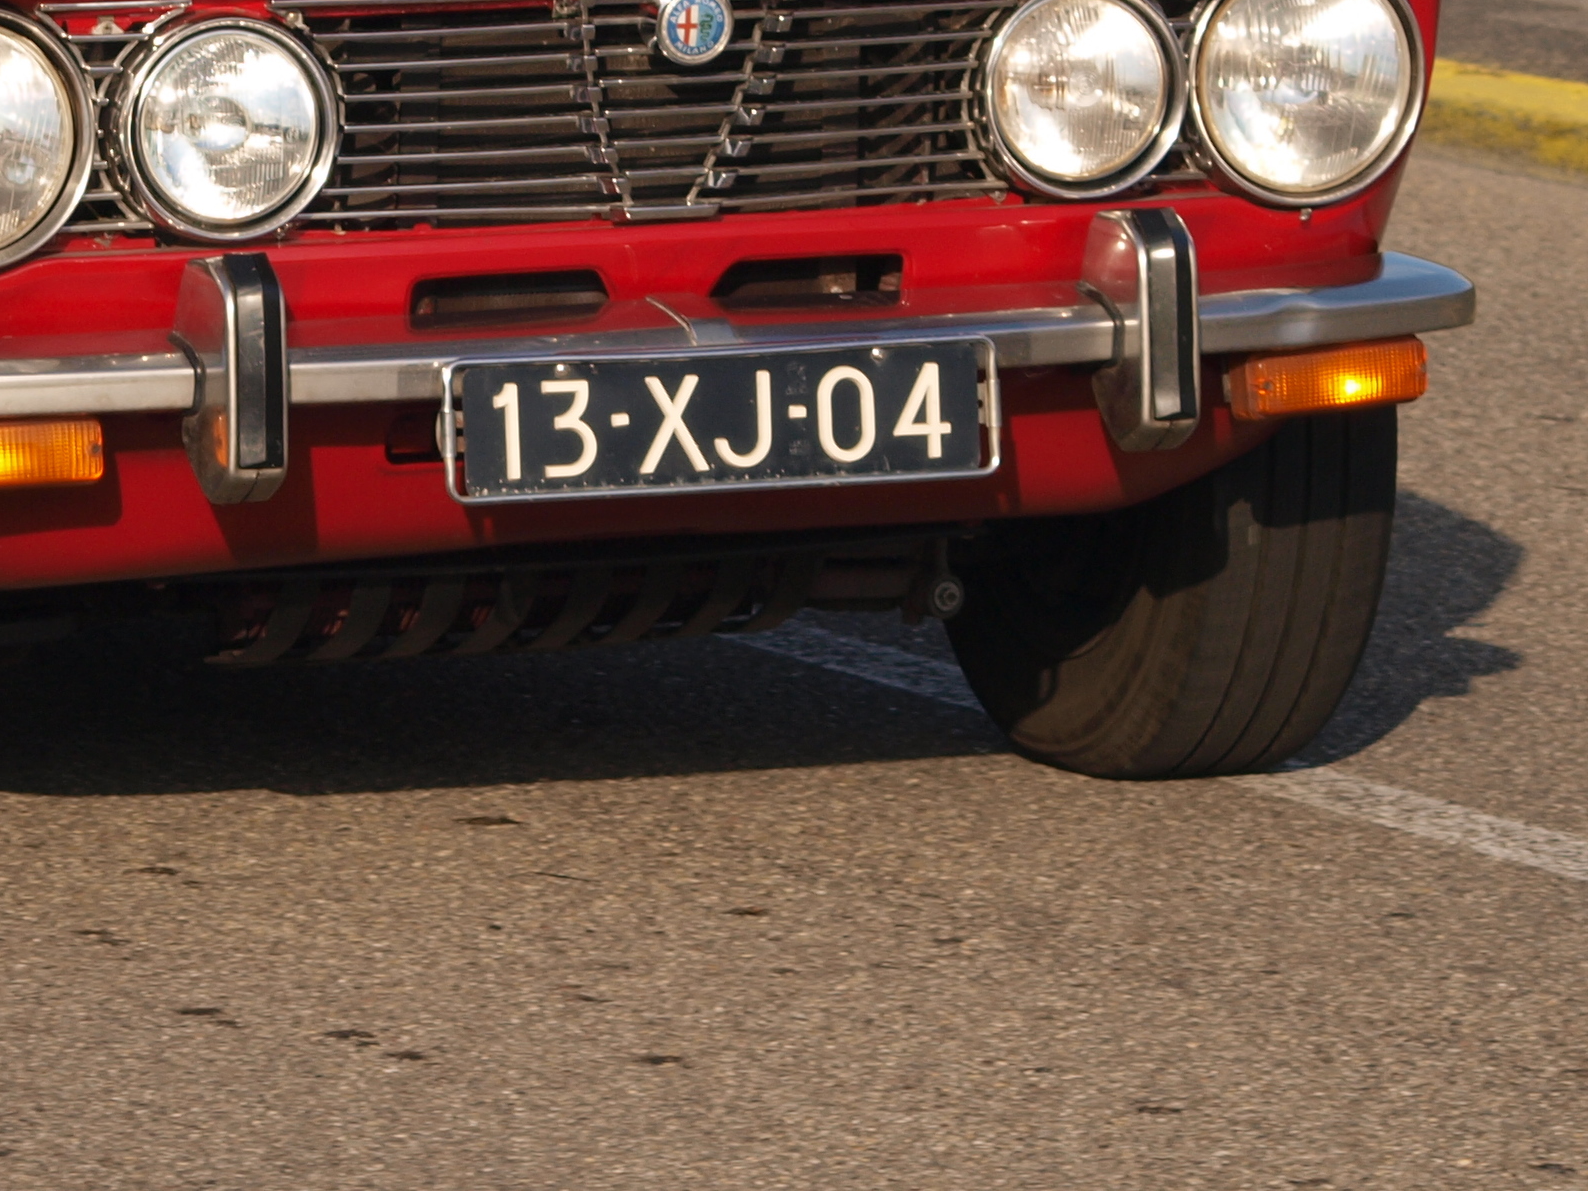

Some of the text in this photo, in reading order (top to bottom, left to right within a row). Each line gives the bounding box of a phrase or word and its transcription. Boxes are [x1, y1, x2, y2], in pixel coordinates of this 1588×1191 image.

[670, 0, 690, 23] ALFA
[675, 41, 714, 54] MILANO
[492, 362, 952, 480] 13-XJ-04
